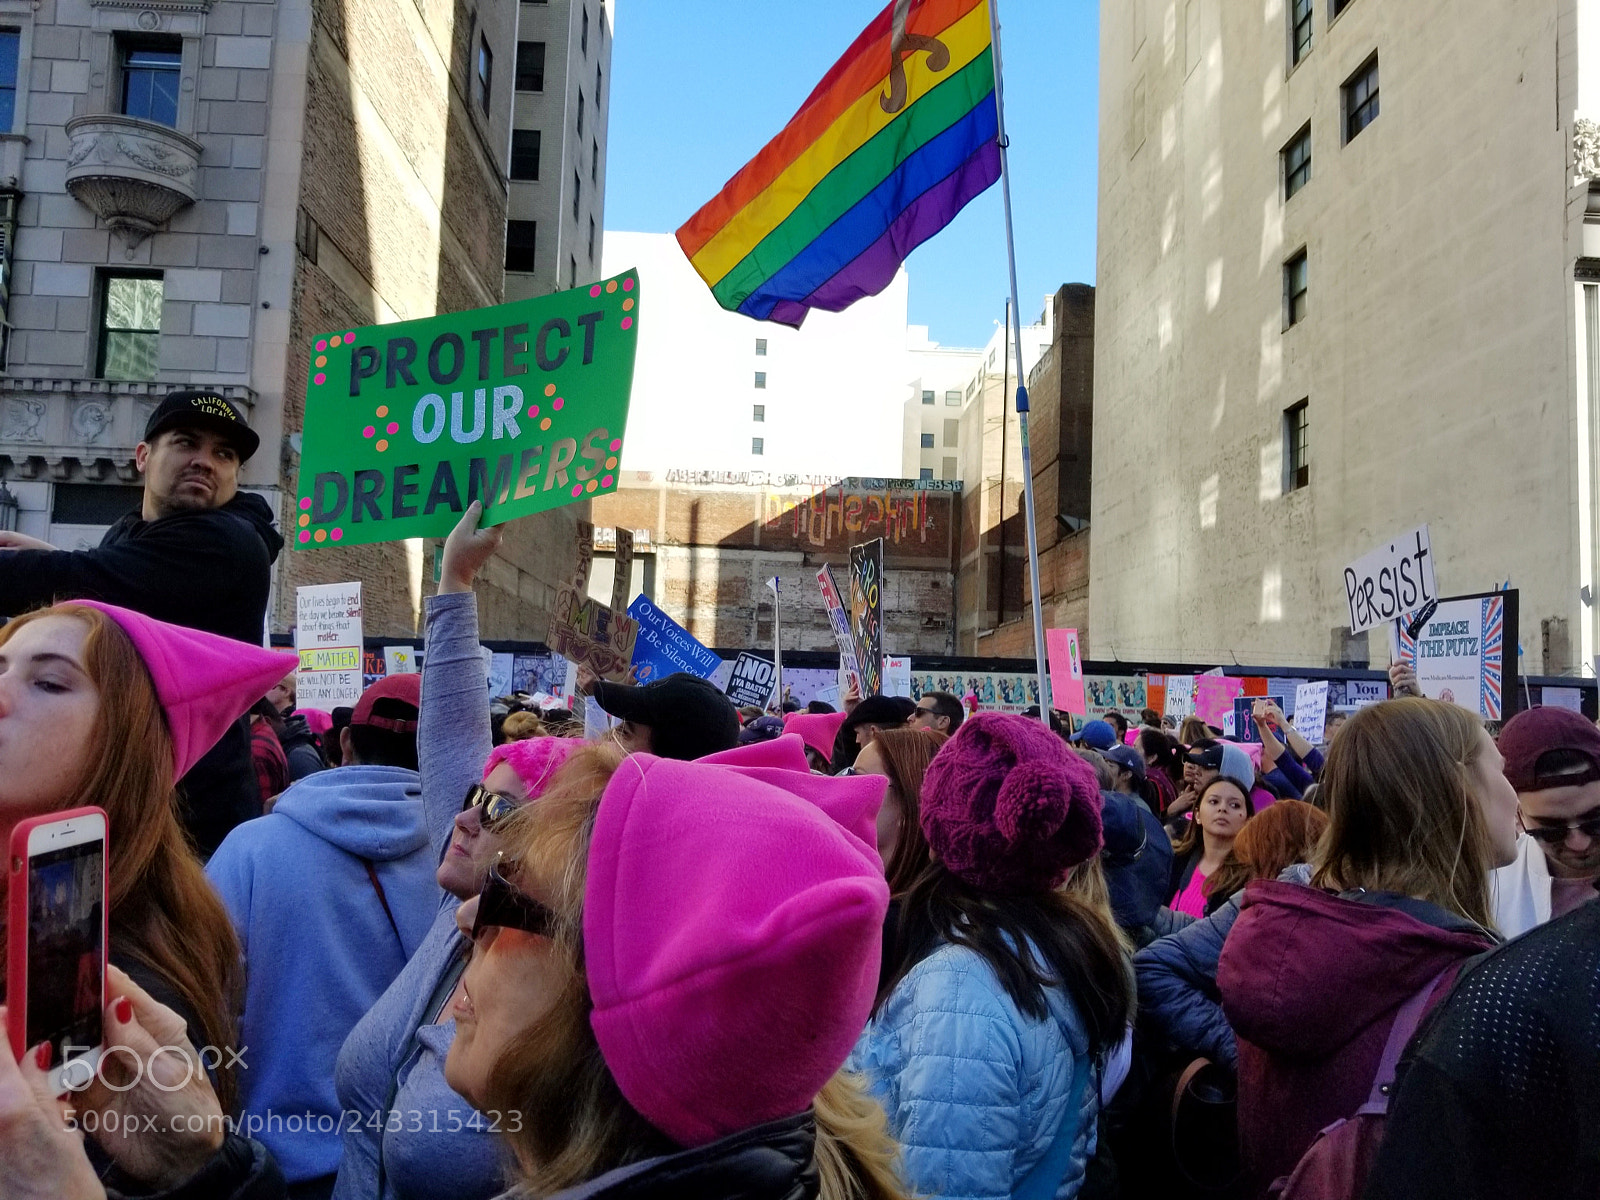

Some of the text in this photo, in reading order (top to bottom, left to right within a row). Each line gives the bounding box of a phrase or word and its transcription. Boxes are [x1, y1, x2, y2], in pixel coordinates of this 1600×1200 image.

[350, 311, 605, 397] PROTECT
[191, 396, 236, 421] CALIFORNIA
[412, 385, 524, 444] OUR
[312, 427, 610, 525] DREAMERS
[300, 597, 311, 609] Our
[312, 595, 325, 607] lives
[347, 593, 359, 605] end
[310, 610, 319, 622] day
[302, 620, 350, 631] about things that
[1428, 620, 1470, 637] IMPEACH
[640, 602, 715, 668] Our Voices Will
[646, 630, 662, 648] Be
[1420, 637, 1479, 658] THE PUTZ
[300, 653, 313, 667] WE
[298, 676, 305, 685] WE
[320, 673, 336, 685] NOT
[339, 673, 351, 684] BE
[297, 689, 317, 699] SILENT
[318, 688, 332, 698] ANY
[745, 681, 770, 697] BASTA!
[1355, 683, 1379, 695] You
